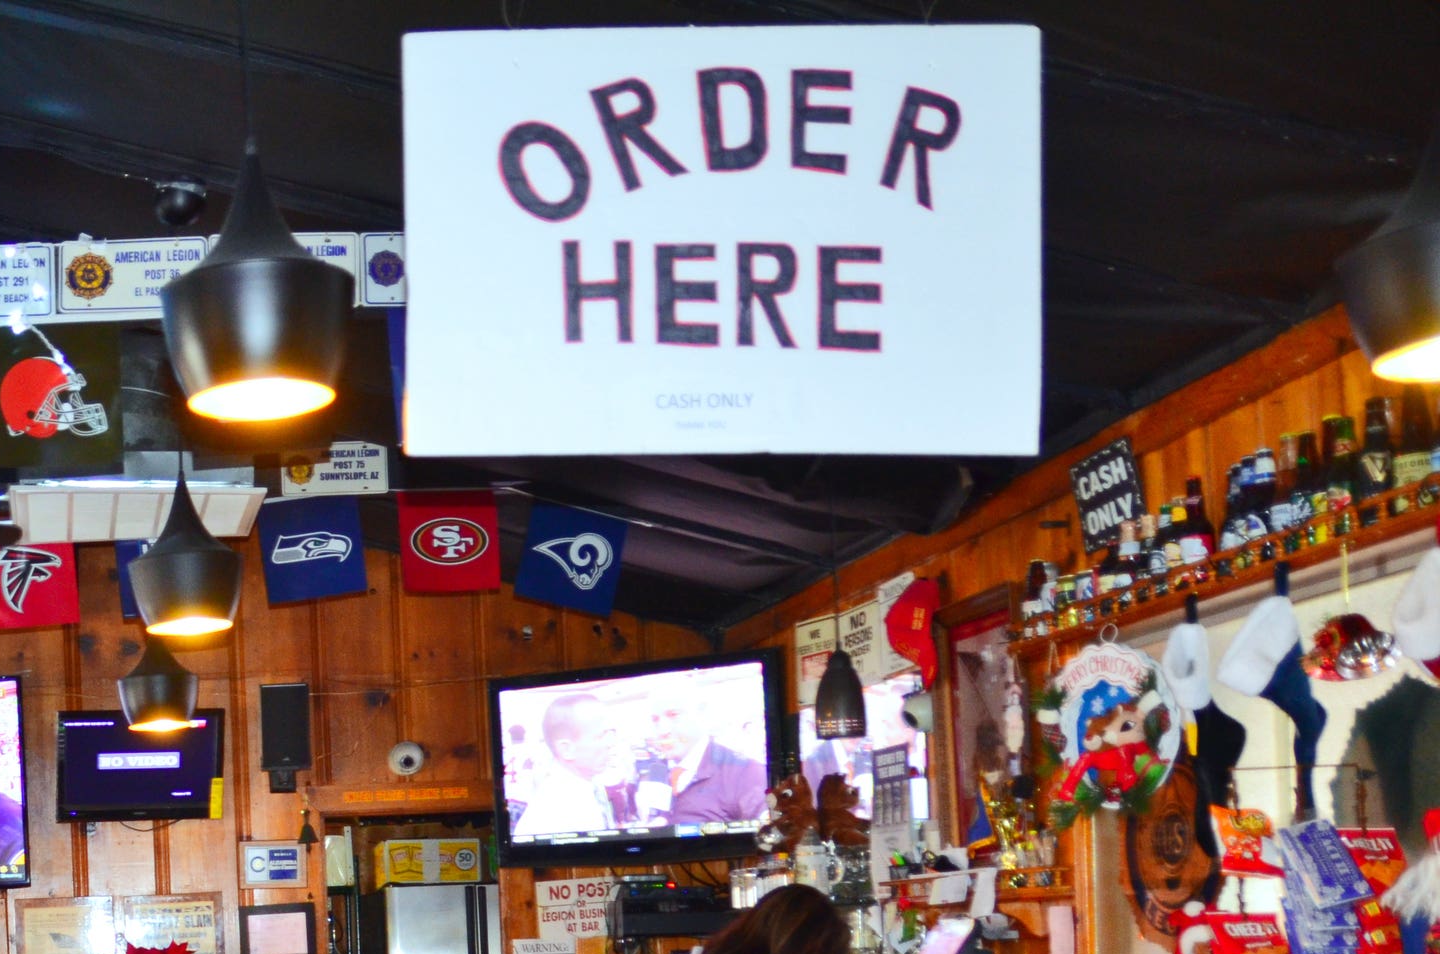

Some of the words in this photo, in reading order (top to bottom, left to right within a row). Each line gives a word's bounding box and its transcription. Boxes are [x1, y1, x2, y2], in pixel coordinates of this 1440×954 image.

[498, 67, 961, 222] ORDER
[114, 251, 161, 263] AMERICAN
[167, 249, 201, 261] LEGION
[316, 246, 348, 258] LEGION
[13, 275, 30, 287] 291
[144, 269, 167, 281] POST
[134, 287, 143, 298] EL
[561, 241, 882, 352] HERE
[655, 393, 701, 409] CASH
[707, 392, 753, 408] ONLY
[333, 460, 354, 470] POST
[356, 460, 366, 470] 75
[370, 471, 380, 480] AZ
[1078, 457, 1128, 500] CASH
[1086, 493, 1133, 536] ONLY
[850, 612, 866, 630] NO
[126, 755, 178, 767] VIDEO
[459, 852, 472, 863] 50
[549, 885, 571, 900] NO
[577, 882, 611, 898] POST
[576, 900, 586, 908] OR
[542, 911, 575, 922] LEGION
[567, 923, 577, 933] AT
[582, 921, 600, 932] BAR
